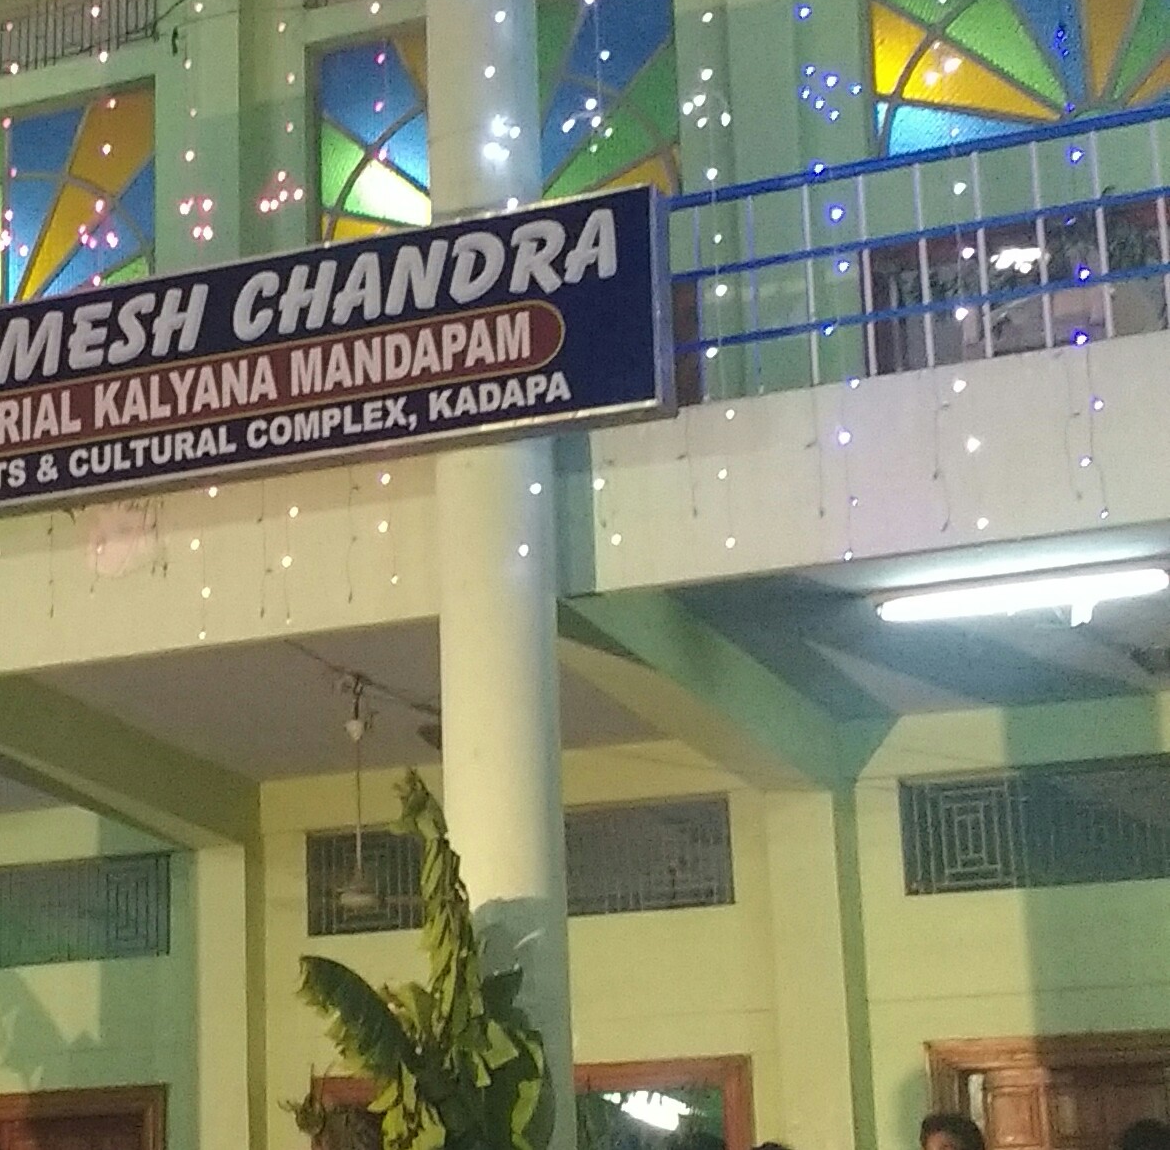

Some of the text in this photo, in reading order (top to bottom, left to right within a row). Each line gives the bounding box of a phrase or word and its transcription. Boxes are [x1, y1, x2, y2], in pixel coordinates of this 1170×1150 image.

[232, 208, 618, 342] CHANDRA
[36, 453, 59, 484] &
[68, 427, 237, 475] CULTURAL
[246, 395, 418, 449] COMPLEX,
[427, 371, 571, 421] KADAPA
[94, 358, 277, 429] KALYANA
[290, 310, 531, 397] MANDAPAM
